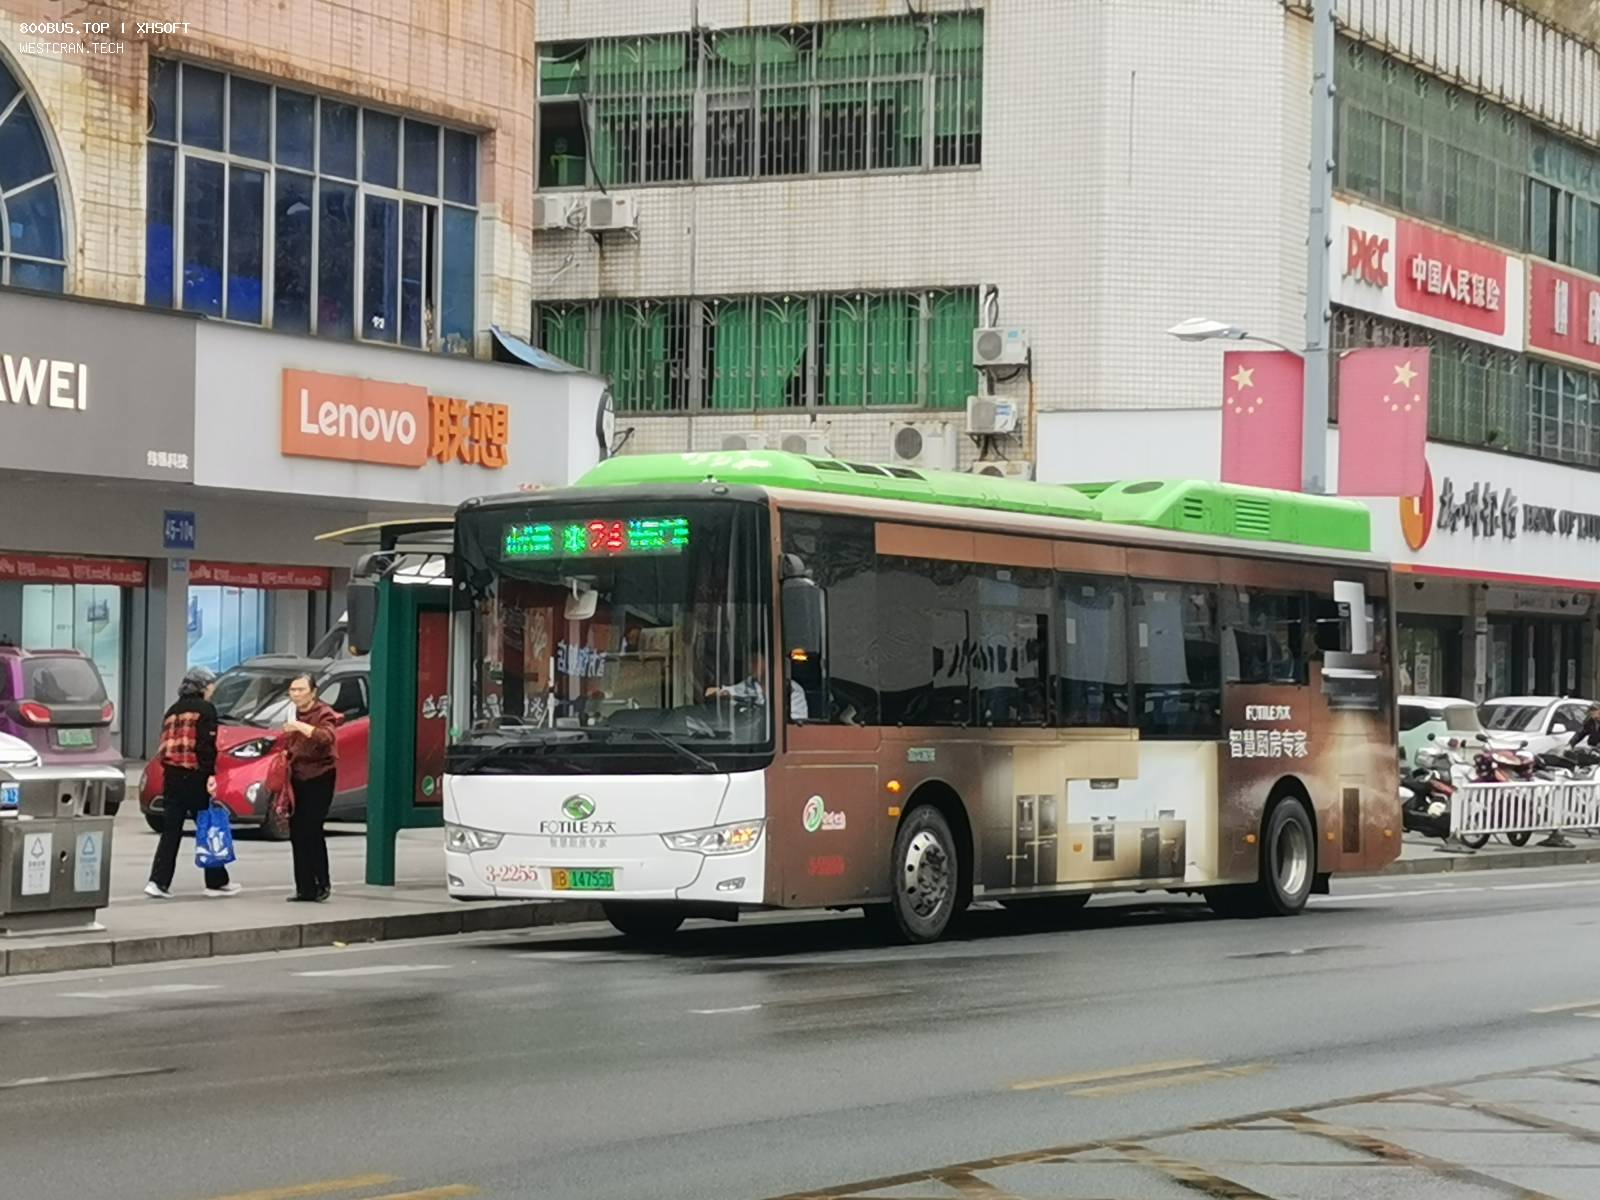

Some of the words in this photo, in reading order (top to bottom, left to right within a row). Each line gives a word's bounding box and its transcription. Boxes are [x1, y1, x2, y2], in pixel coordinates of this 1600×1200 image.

[1344, 226, 1389, 288] PICC
[1411, 252, 1500, 311] 中国人民保险
[0, 354, 87, 411] WEI
[300, 387, 417, 446] Lenovo
[427, 394, 510, 469] 联想
[540, 820, 589, 834] FOTILE
[590, 820, 617, 834] 方太
[485, 863, 539, 883] 3-2255
